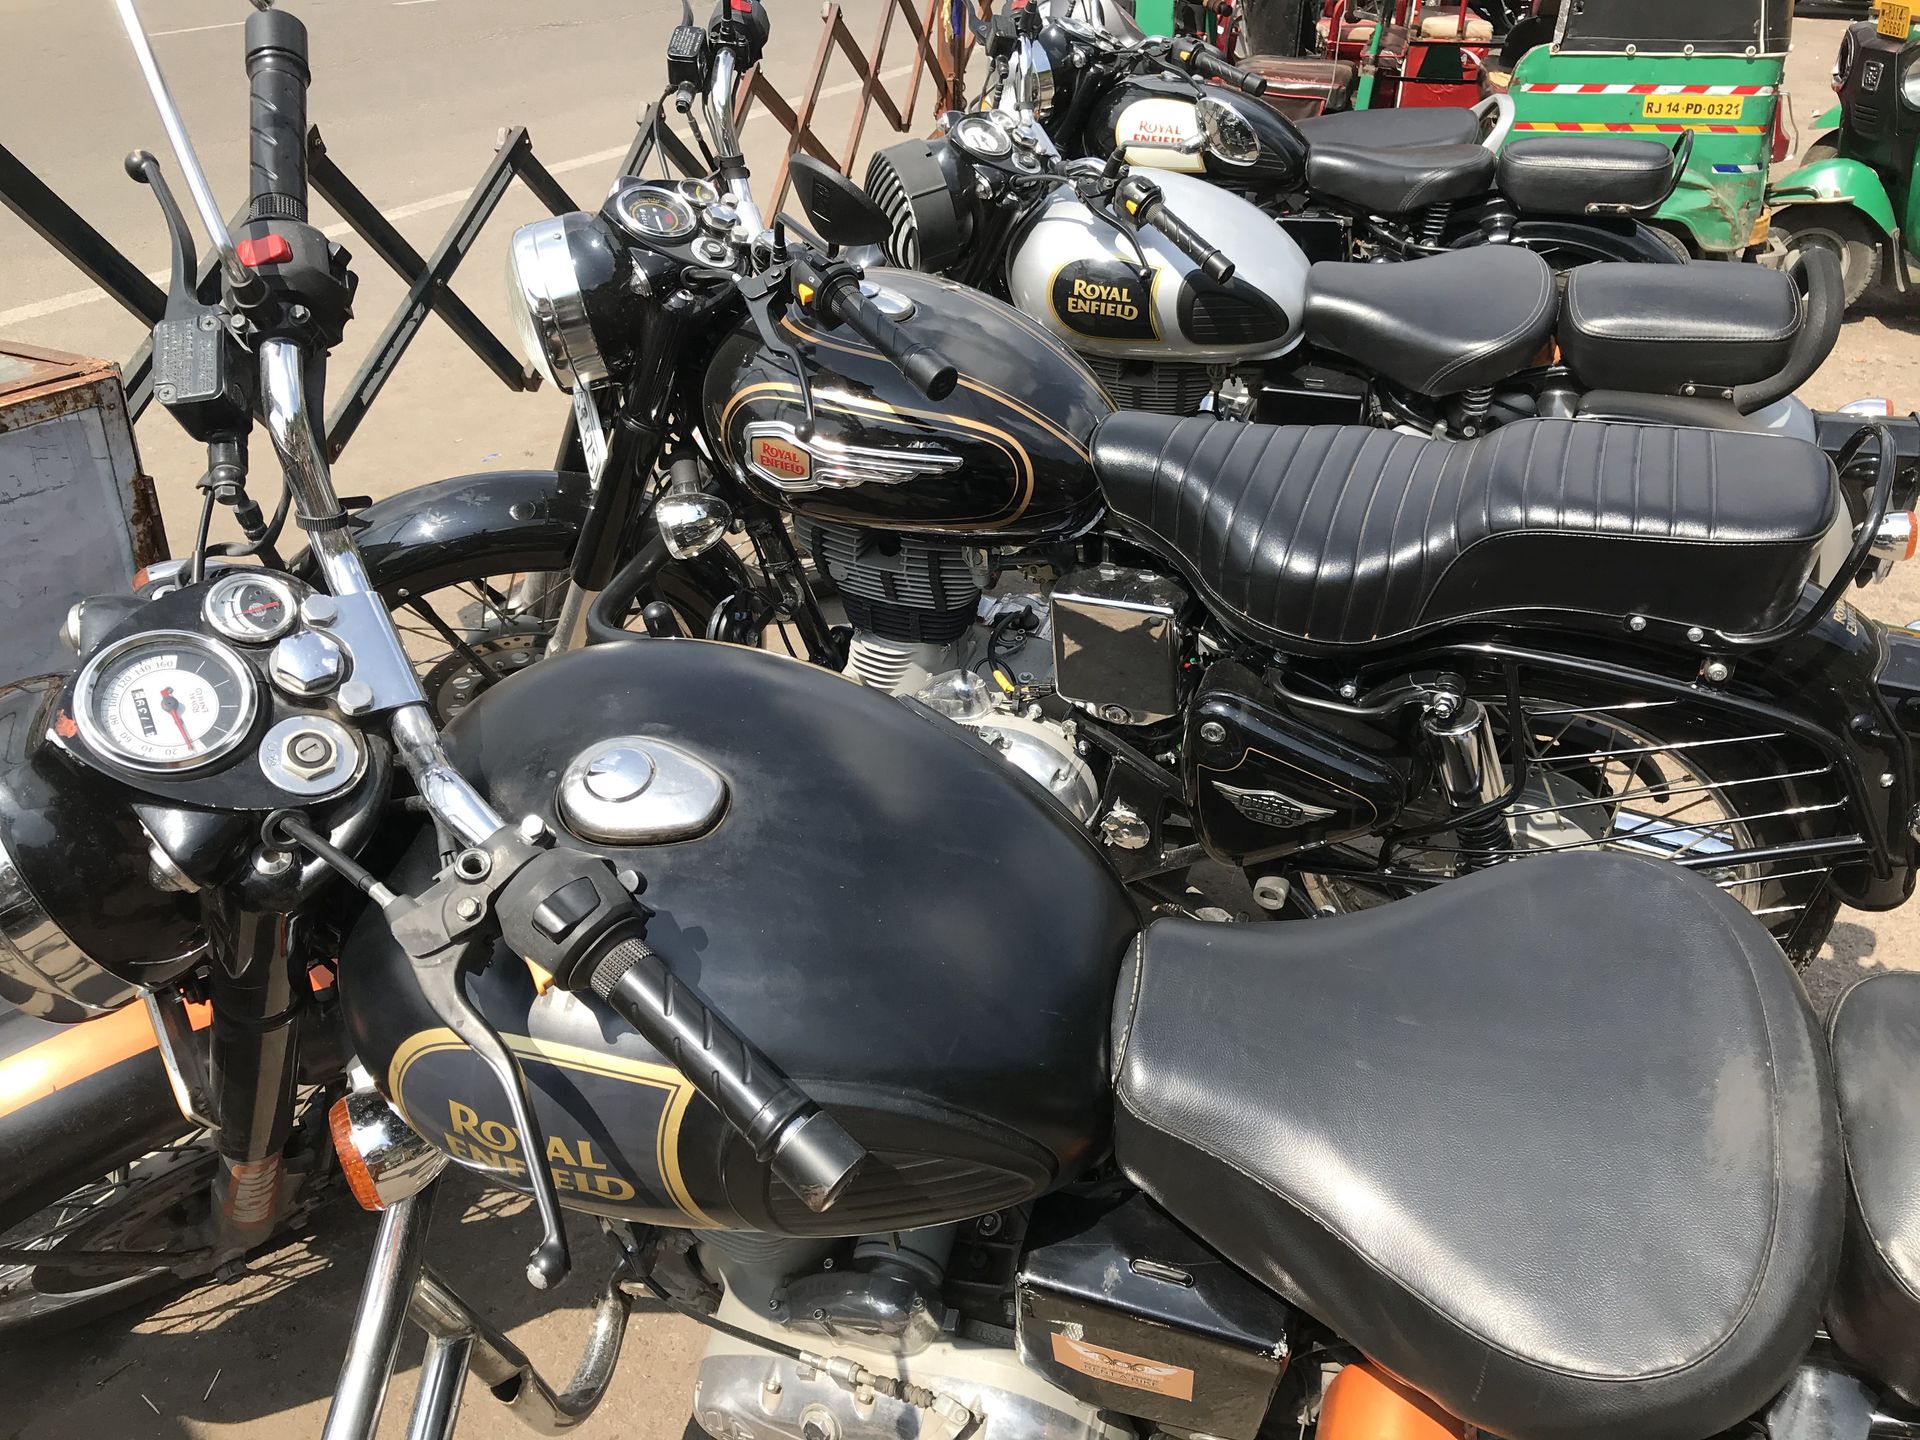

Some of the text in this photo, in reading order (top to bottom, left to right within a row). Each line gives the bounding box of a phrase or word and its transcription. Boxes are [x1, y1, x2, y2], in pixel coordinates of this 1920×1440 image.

[1139, 120, 1181, 134] ROYAL
[1073, 279, 1132, 302] ROYAL
[1067, 297, 1139, 320] ENFIELD
[762, 442, 799, 463] ROYAL
[760, 455, 805, 475] ENFIELD
[134, 664, 152, 676] 140
[156, 660, 174, 668] 160
[117, 675, 132, 689] 120
[109, 692, 118, 708] 100
[109, 714, 119, 726] 80
[120, 732, 133, 743] 60
[141, 744, 154, 754] 40
[165, 748, 178, 756] 20
[448, 1099, 607, 1170] ROAL
[444, 1132, 636, 1201] ENFELD
